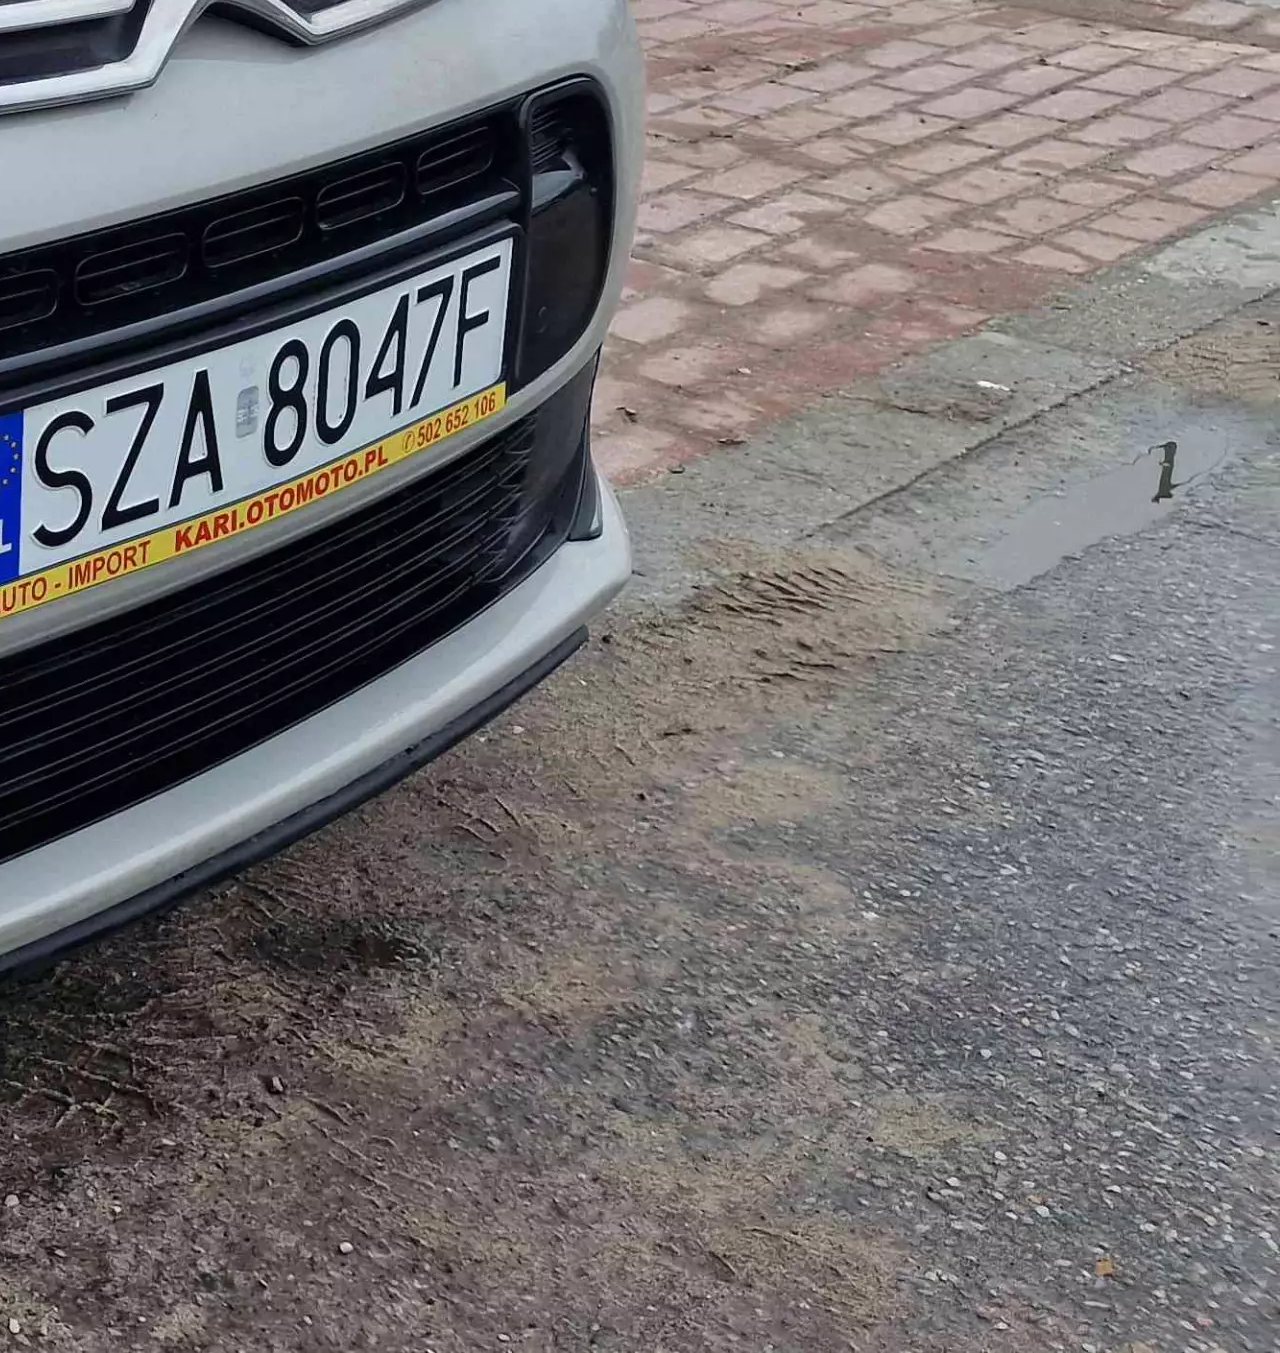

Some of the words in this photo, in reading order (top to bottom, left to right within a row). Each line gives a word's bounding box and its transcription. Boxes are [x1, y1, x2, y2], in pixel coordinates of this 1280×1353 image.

[30, 367, 225, 547] SZA
[262, 254, 502, 467] 8047F
[68, 540, 151, 590] IMPORT
[174, 445, 389, 553] KARI.OTOMOTO.PL
[417, 418, 442, 447] 502
[445, 405, 470, 433] 652
[473, 391, 497, 418] 106
